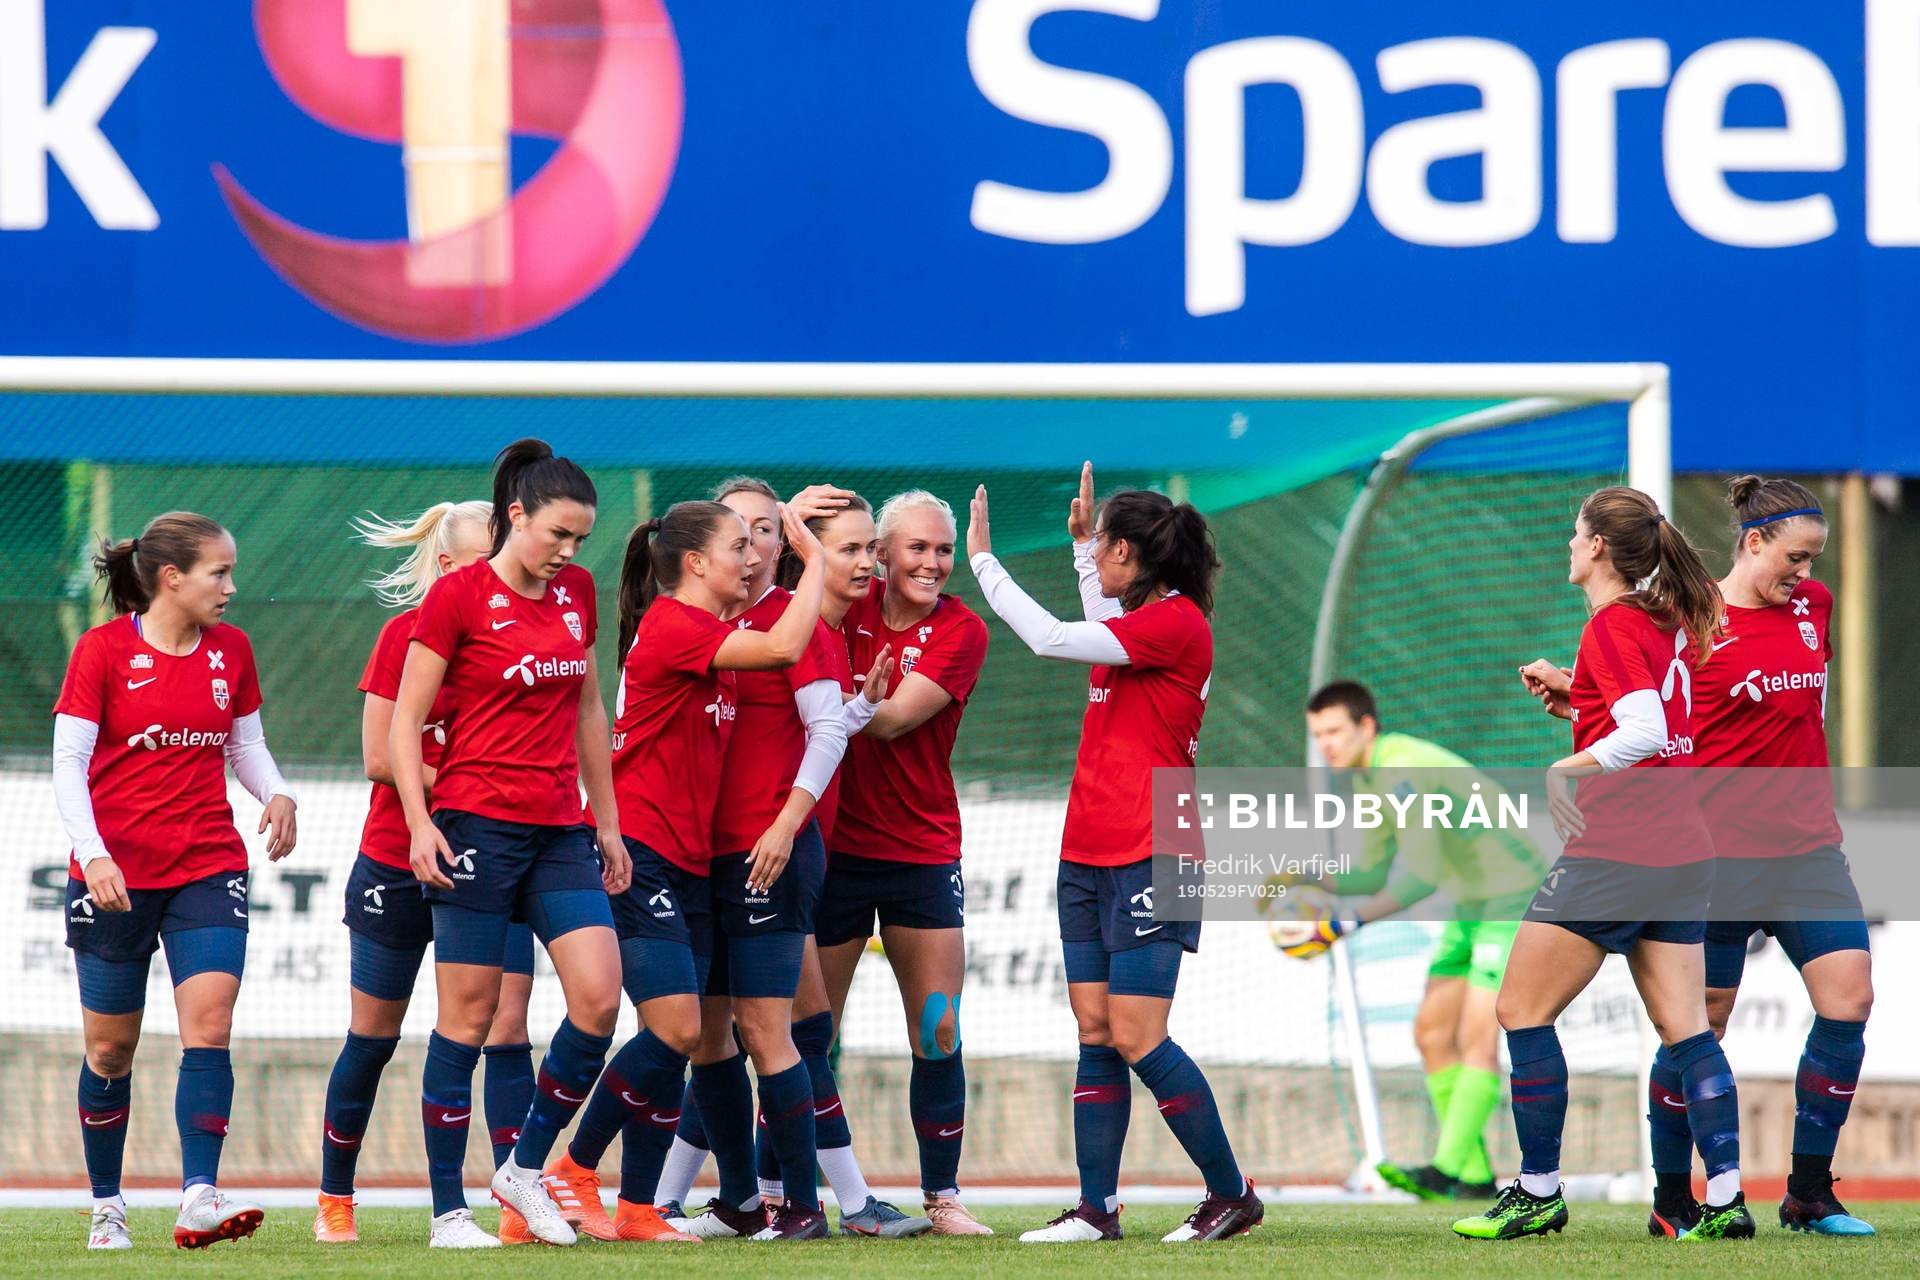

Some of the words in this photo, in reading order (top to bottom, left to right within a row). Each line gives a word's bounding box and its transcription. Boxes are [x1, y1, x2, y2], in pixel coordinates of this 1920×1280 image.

[160, 727, 229, 747] telenor
[452, 871, 476, 881] telenor
[744, 896, 770, 904] telenor
[70, 915, 95, 925] telenor
